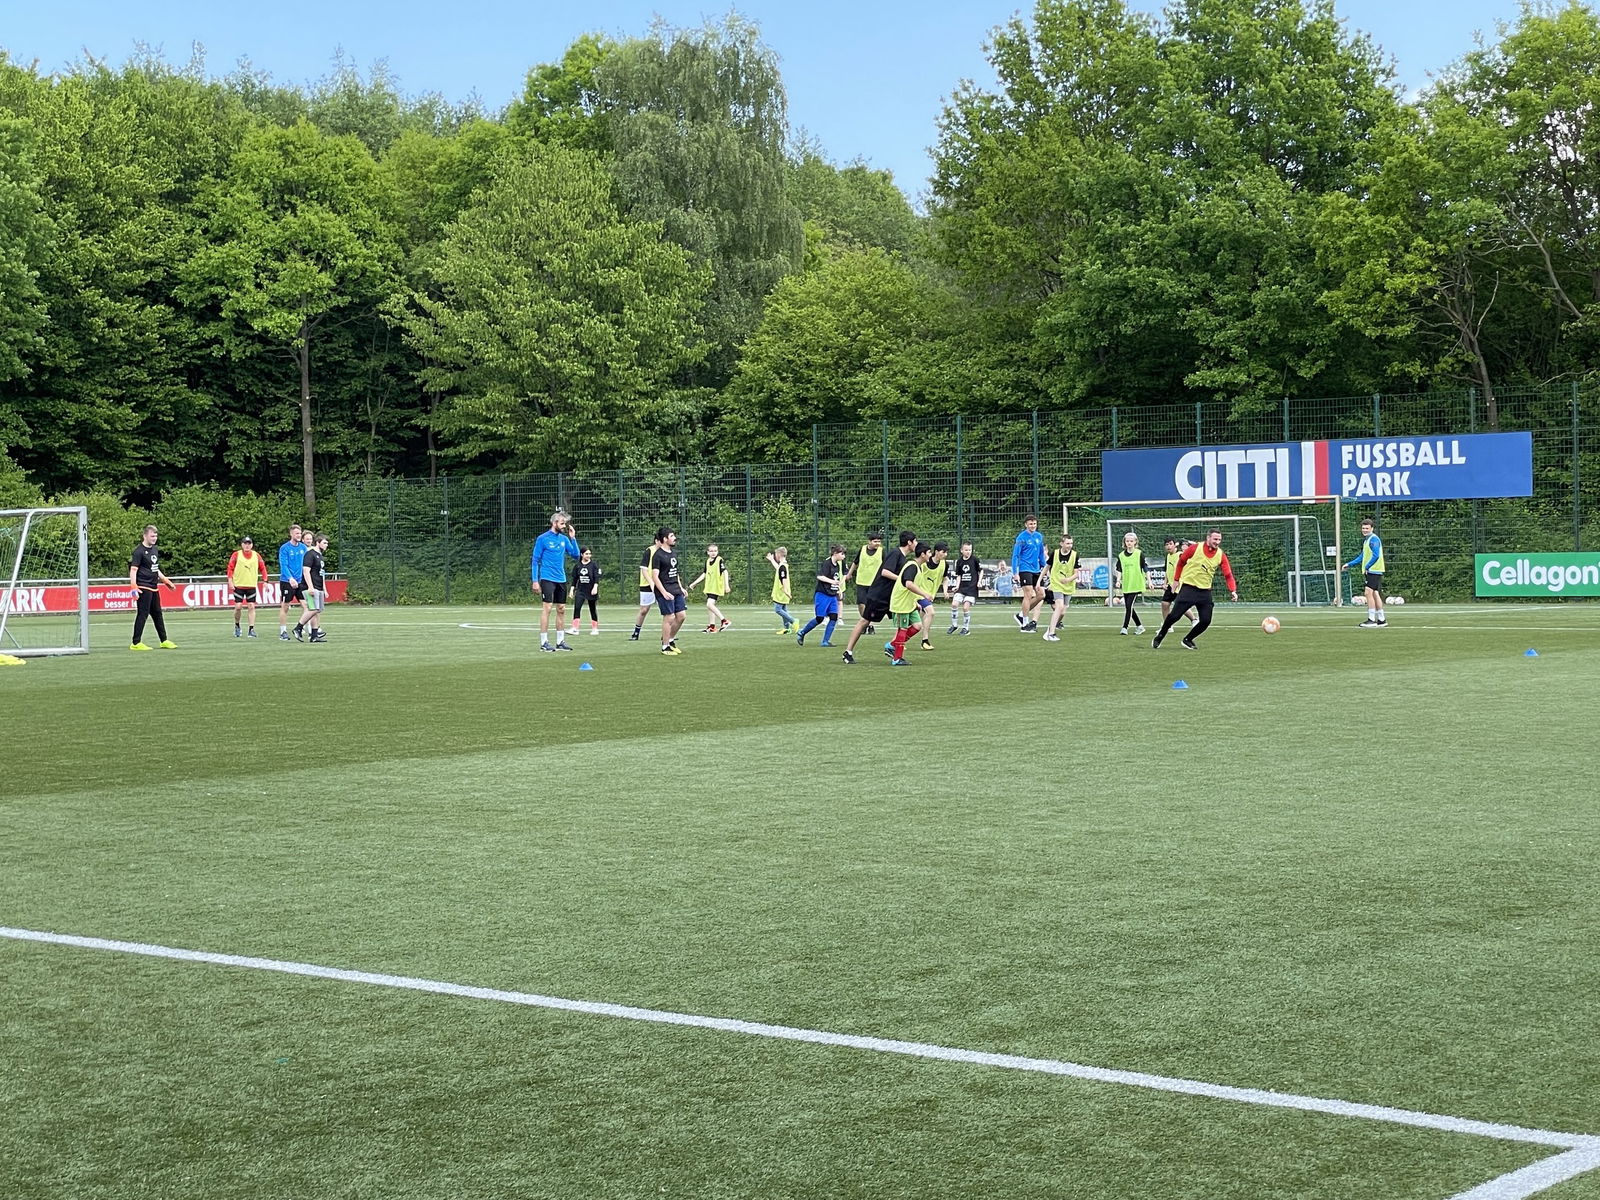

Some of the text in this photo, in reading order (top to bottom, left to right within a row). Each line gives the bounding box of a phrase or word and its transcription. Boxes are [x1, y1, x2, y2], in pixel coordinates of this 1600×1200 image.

[1341, 440, 1467, 469] FUSSBALL
[1174, 448, 1290, 500] CITTI
[1342, 471, 1411, 497] PARK
[1482, 559, 1599, 592] Cellagon
[104, 599, 130, 609] besser
